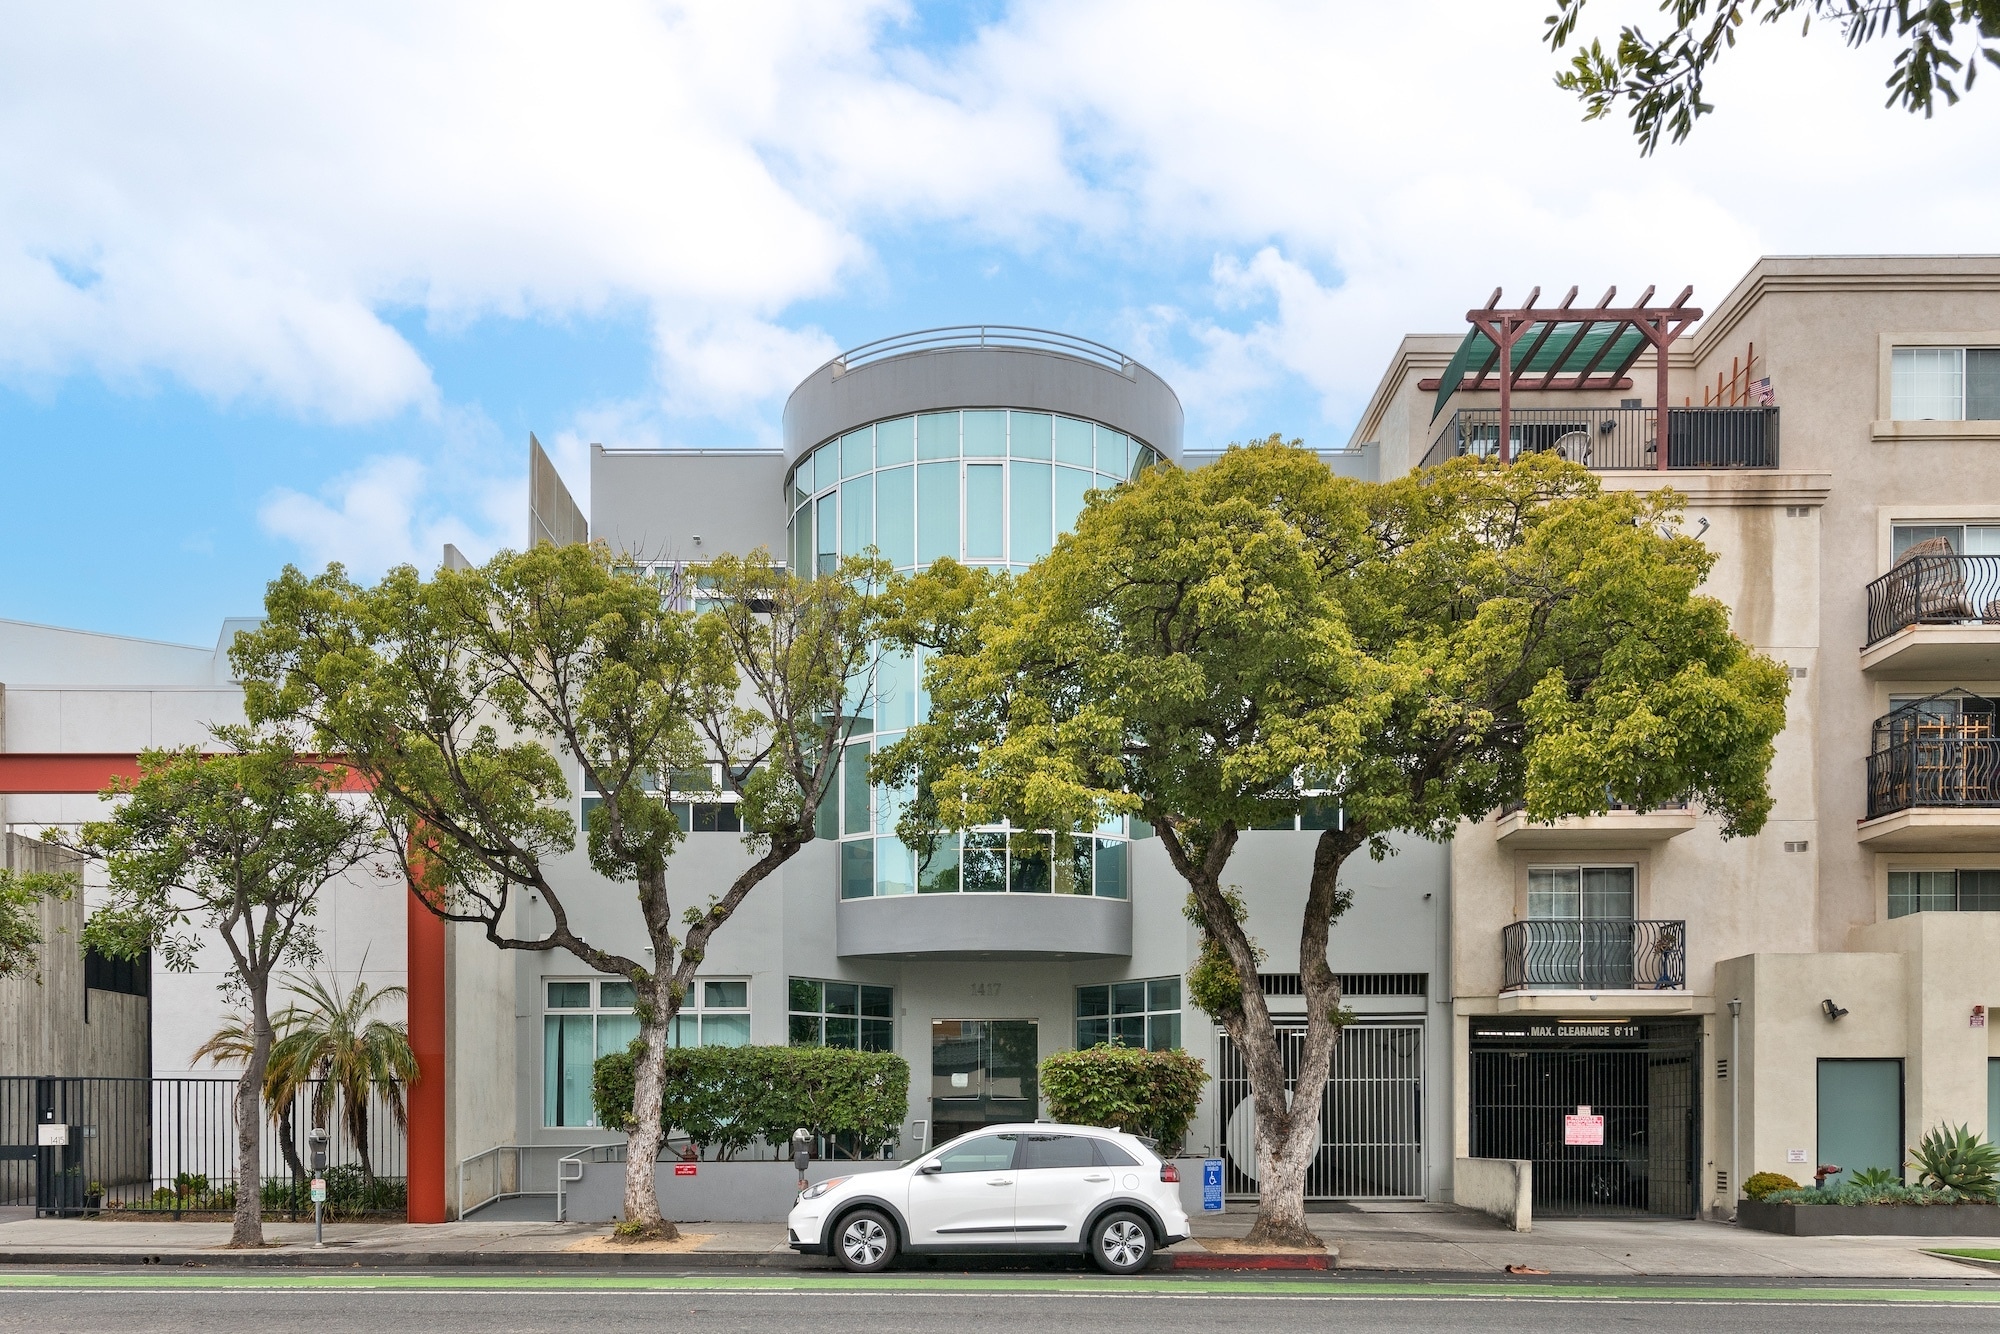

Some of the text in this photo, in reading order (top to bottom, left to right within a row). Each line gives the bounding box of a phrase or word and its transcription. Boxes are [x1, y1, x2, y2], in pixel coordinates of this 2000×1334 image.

[970, 983, 1001, 996] 1417
[1531, 1026, 1555, 1036] MAX.
[1557, 1026, 1610, 1036] CLEARANCE
[50, 1136, 64, 1145] 1415
